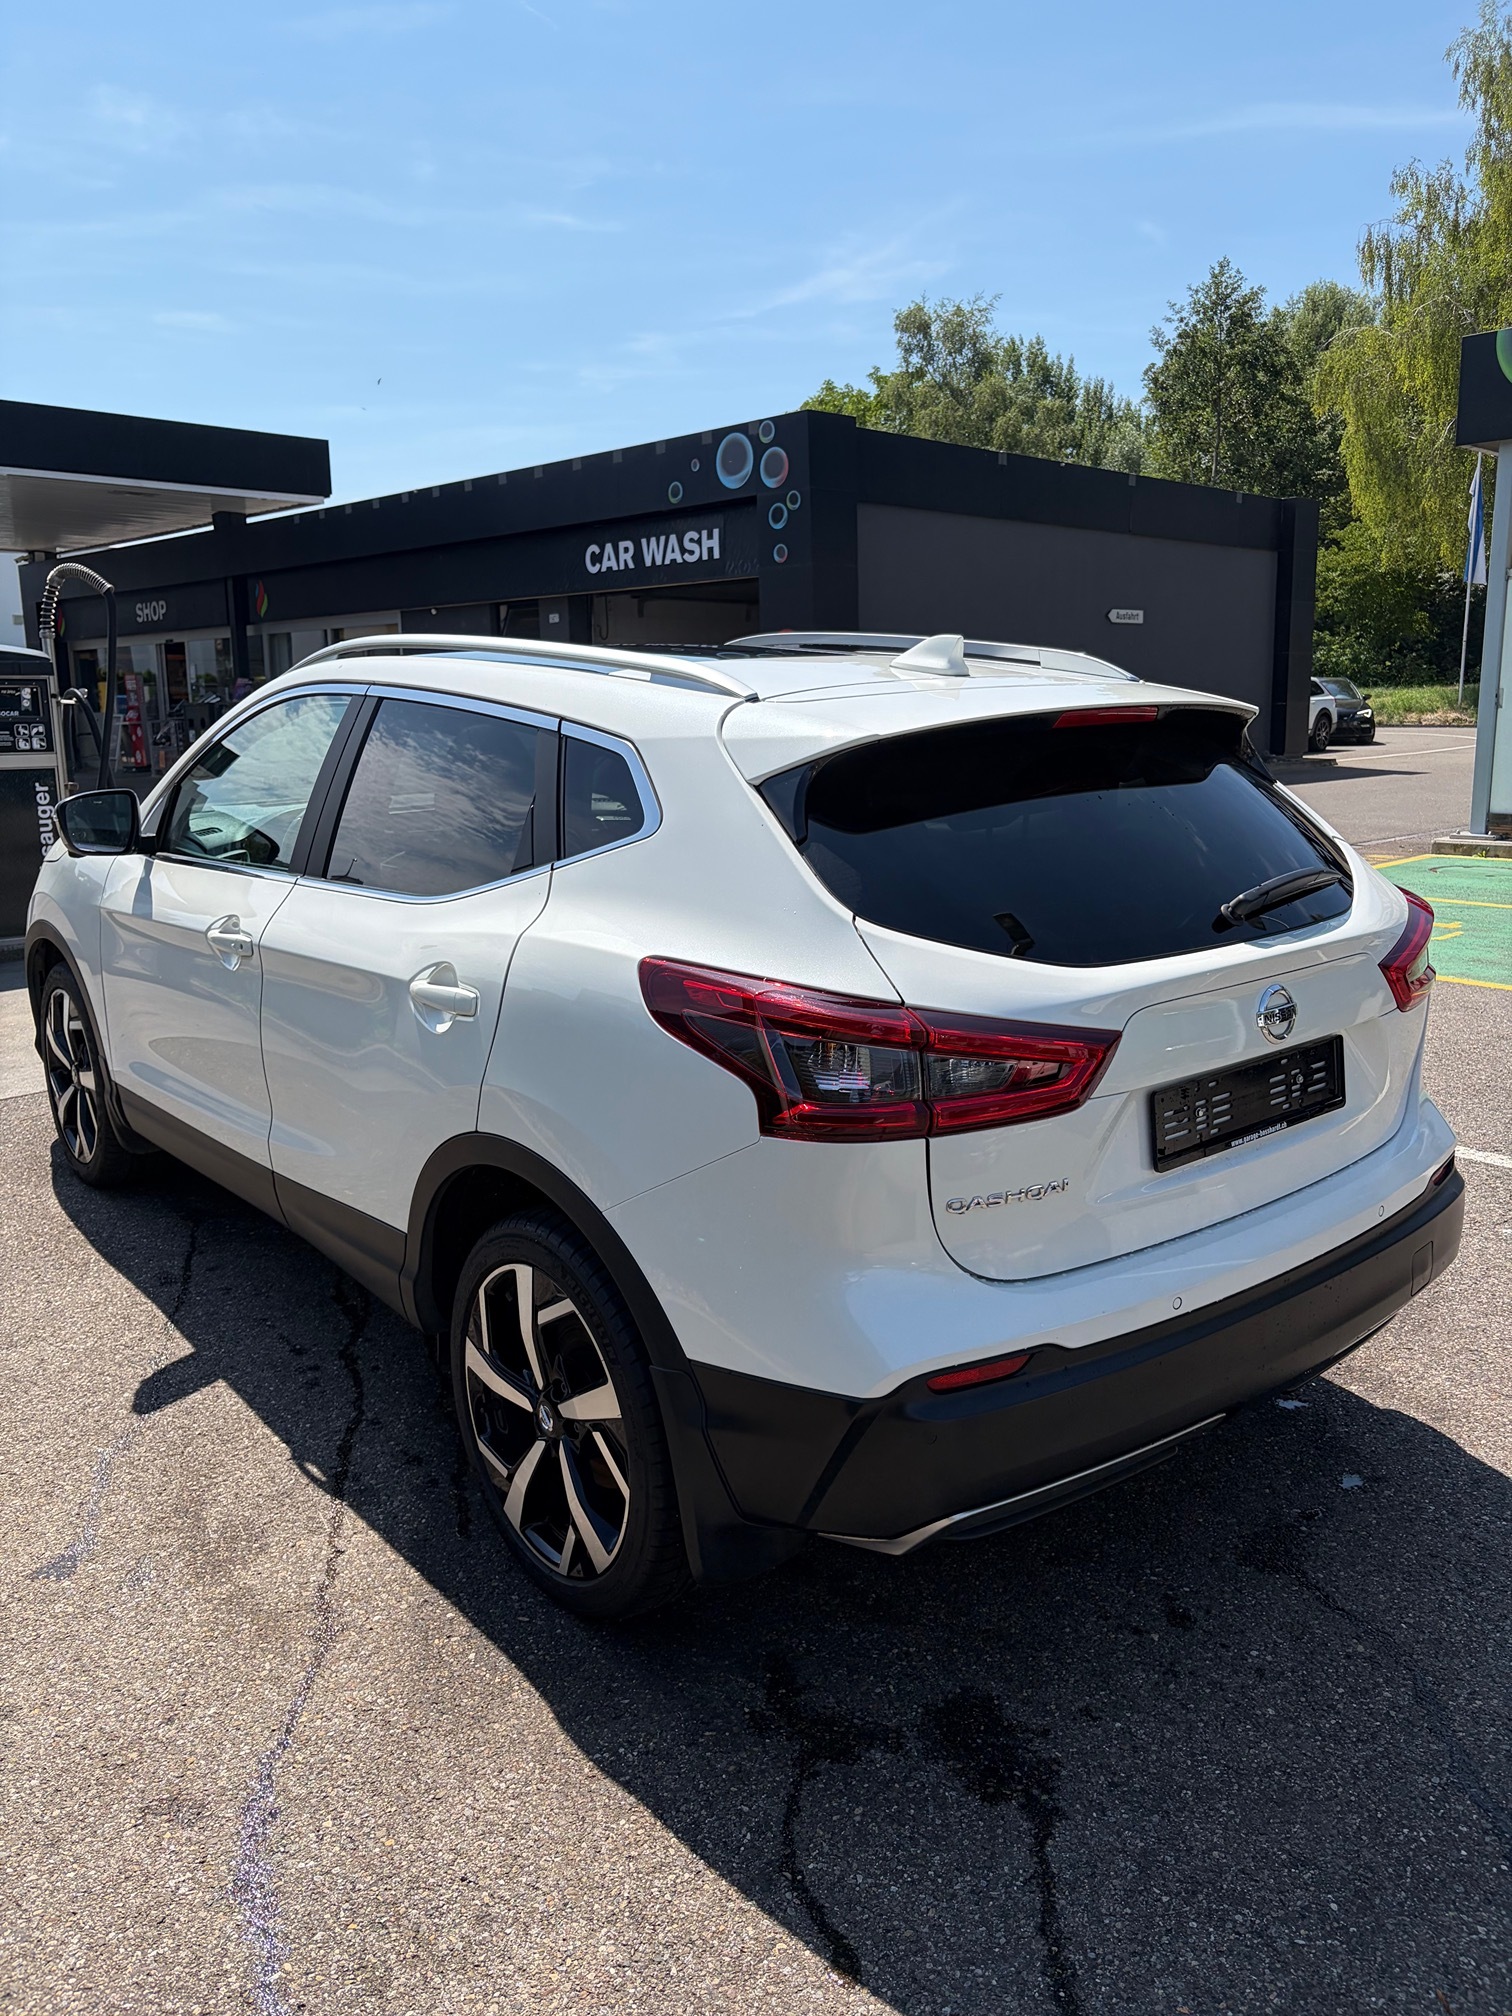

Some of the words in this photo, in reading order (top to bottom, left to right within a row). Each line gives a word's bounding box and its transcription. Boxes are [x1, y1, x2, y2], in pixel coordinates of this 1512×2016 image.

[585, 544, 635, 574] CAR
[641, 528, 720, 567] WASH
[135, 600, 167, 623] SHOP
[1115, 610, 1139, 621] Ausfahrt
[35, 782, 56, 857] sauger
[1261, 1004, 1296, 1026] NISSAN
[946, 1178, 1069, 1215] QASHQAI
[566, 1275, 617, 1360] MICHELIN
